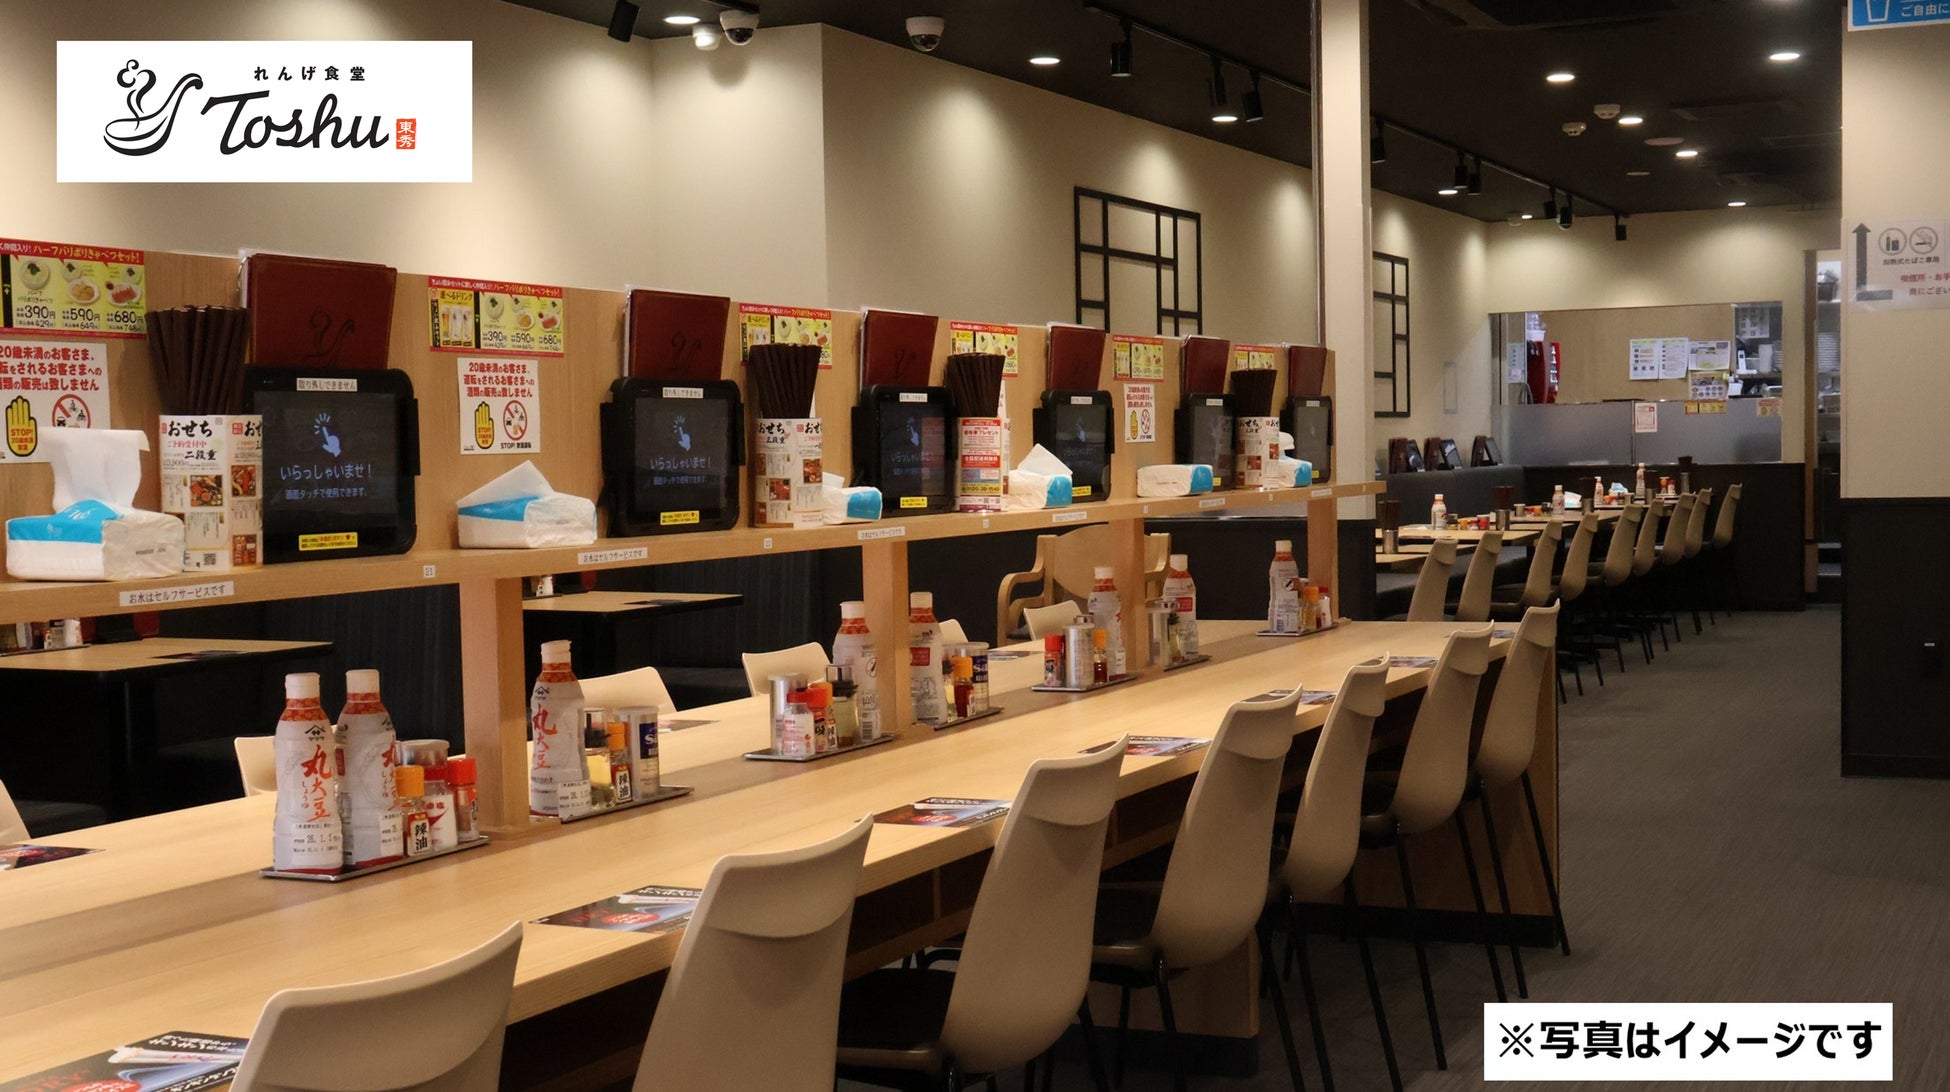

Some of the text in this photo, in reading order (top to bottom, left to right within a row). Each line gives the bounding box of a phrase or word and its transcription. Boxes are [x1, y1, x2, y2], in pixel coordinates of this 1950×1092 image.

[1901, 3, 1950, 17] ご自由に
[0, 377, 100, 391] 類の販売は致しません
[168, 420, 213, 438] おせち
[280, 464, 372, 480] いらっしゃいませ!
[128, 584, 226, 604] お水はセルフサービスです
[532, 702, 558, 771] 丸大豆
[301, 744, 334, 823] 丸大豆
[301, 780, 310, 810] しょうゆ
[415, 822, 428, 851] 辣油
